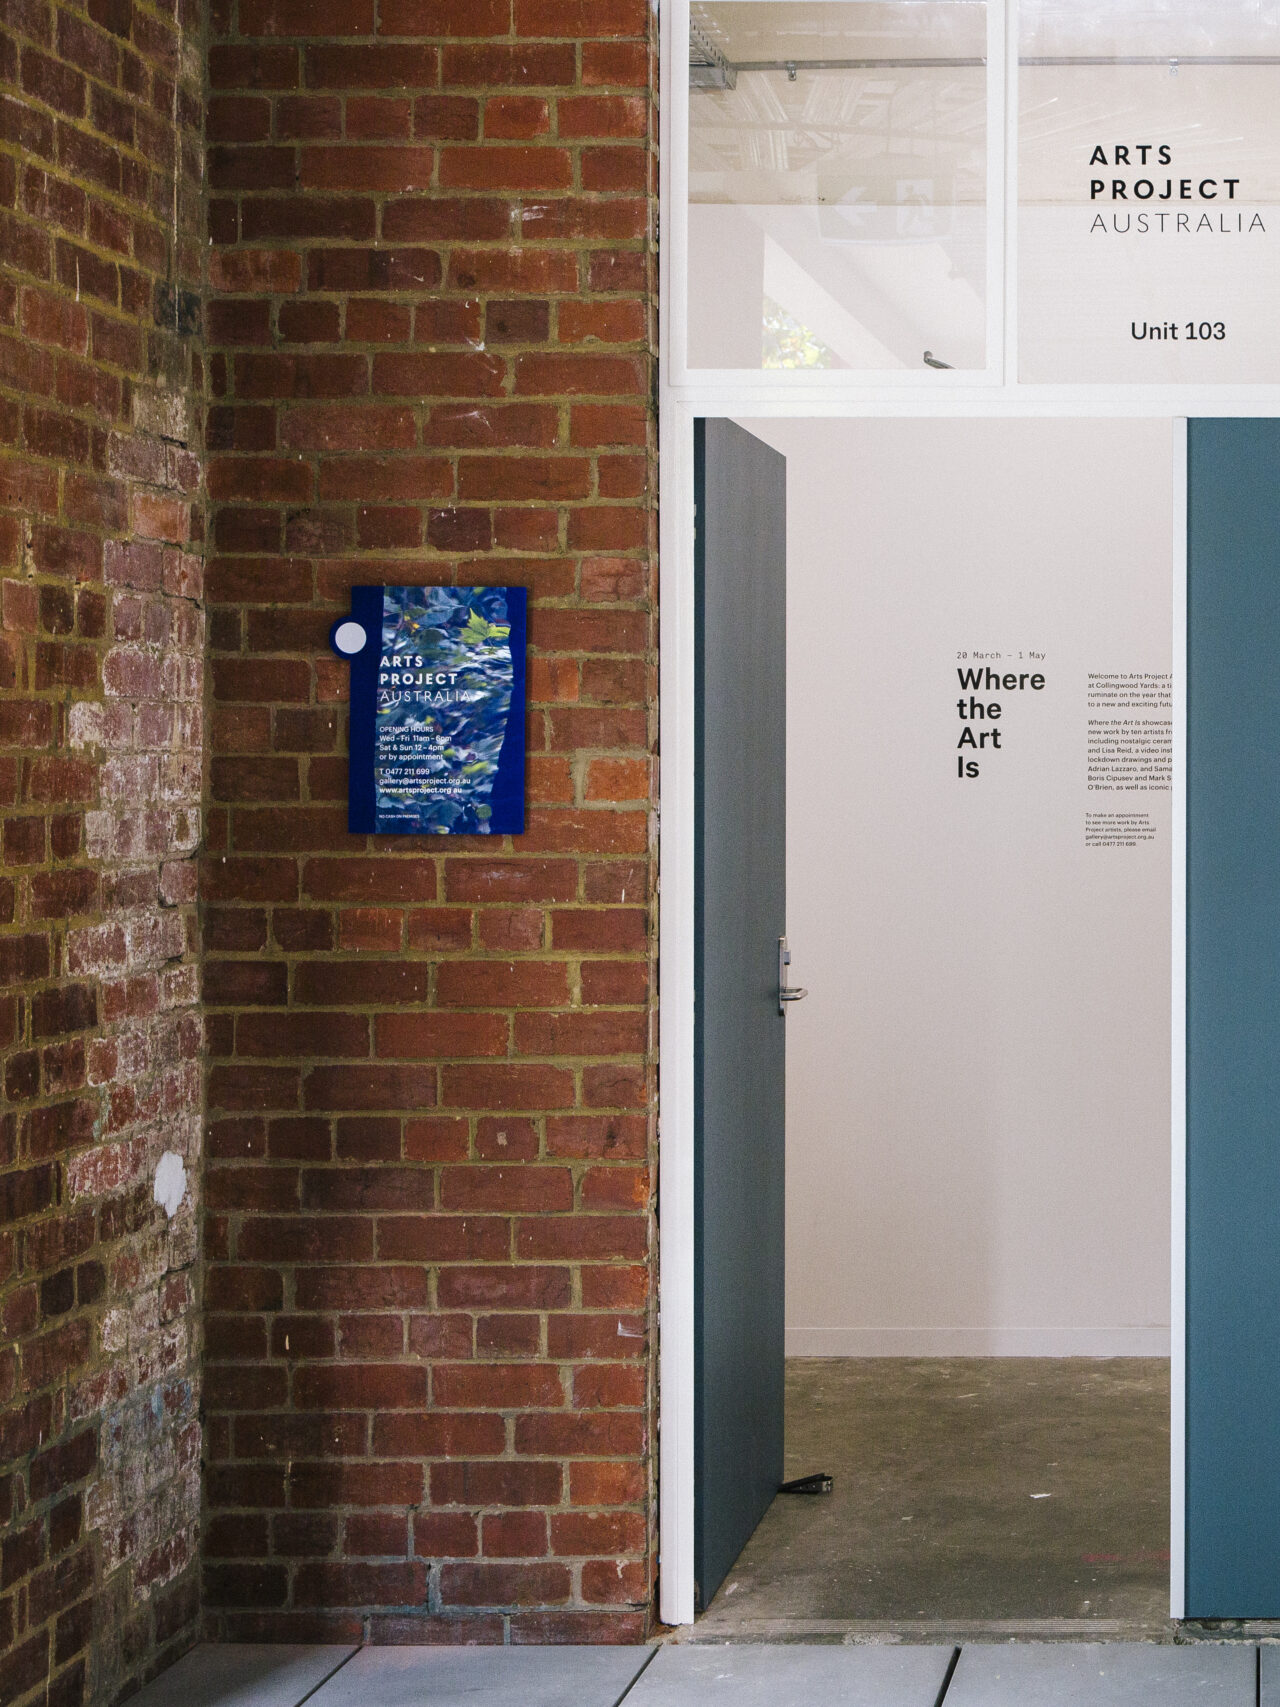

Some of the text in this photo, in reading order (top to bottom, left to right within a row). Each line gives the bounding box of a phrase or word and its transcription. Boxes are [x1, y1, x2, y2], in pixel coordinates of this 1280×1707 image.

[1089, 145, 1171, 165] ARTS
[1091, 179, 1239, 200] PROJECT
[1091, 213, 1265, 233] AUSTRALIA
[1132, 322, 1226, 340] Unit 103
[380, 655, 423, 667] ARTS
[973, 651, 1000, 659] March
[1029, 652, 1046, 660] May
[380, 673, 457, 685] PROJECT
[957, 667, 1045, 690] Where
[380, 691, 471, 702] AUSTRALIA
[957, 697, 1001, 719] the
[436, 735, 451, 743] 6pm
[957, 727, 1001, 748] Art
[958, 756, 979, 778] Is
